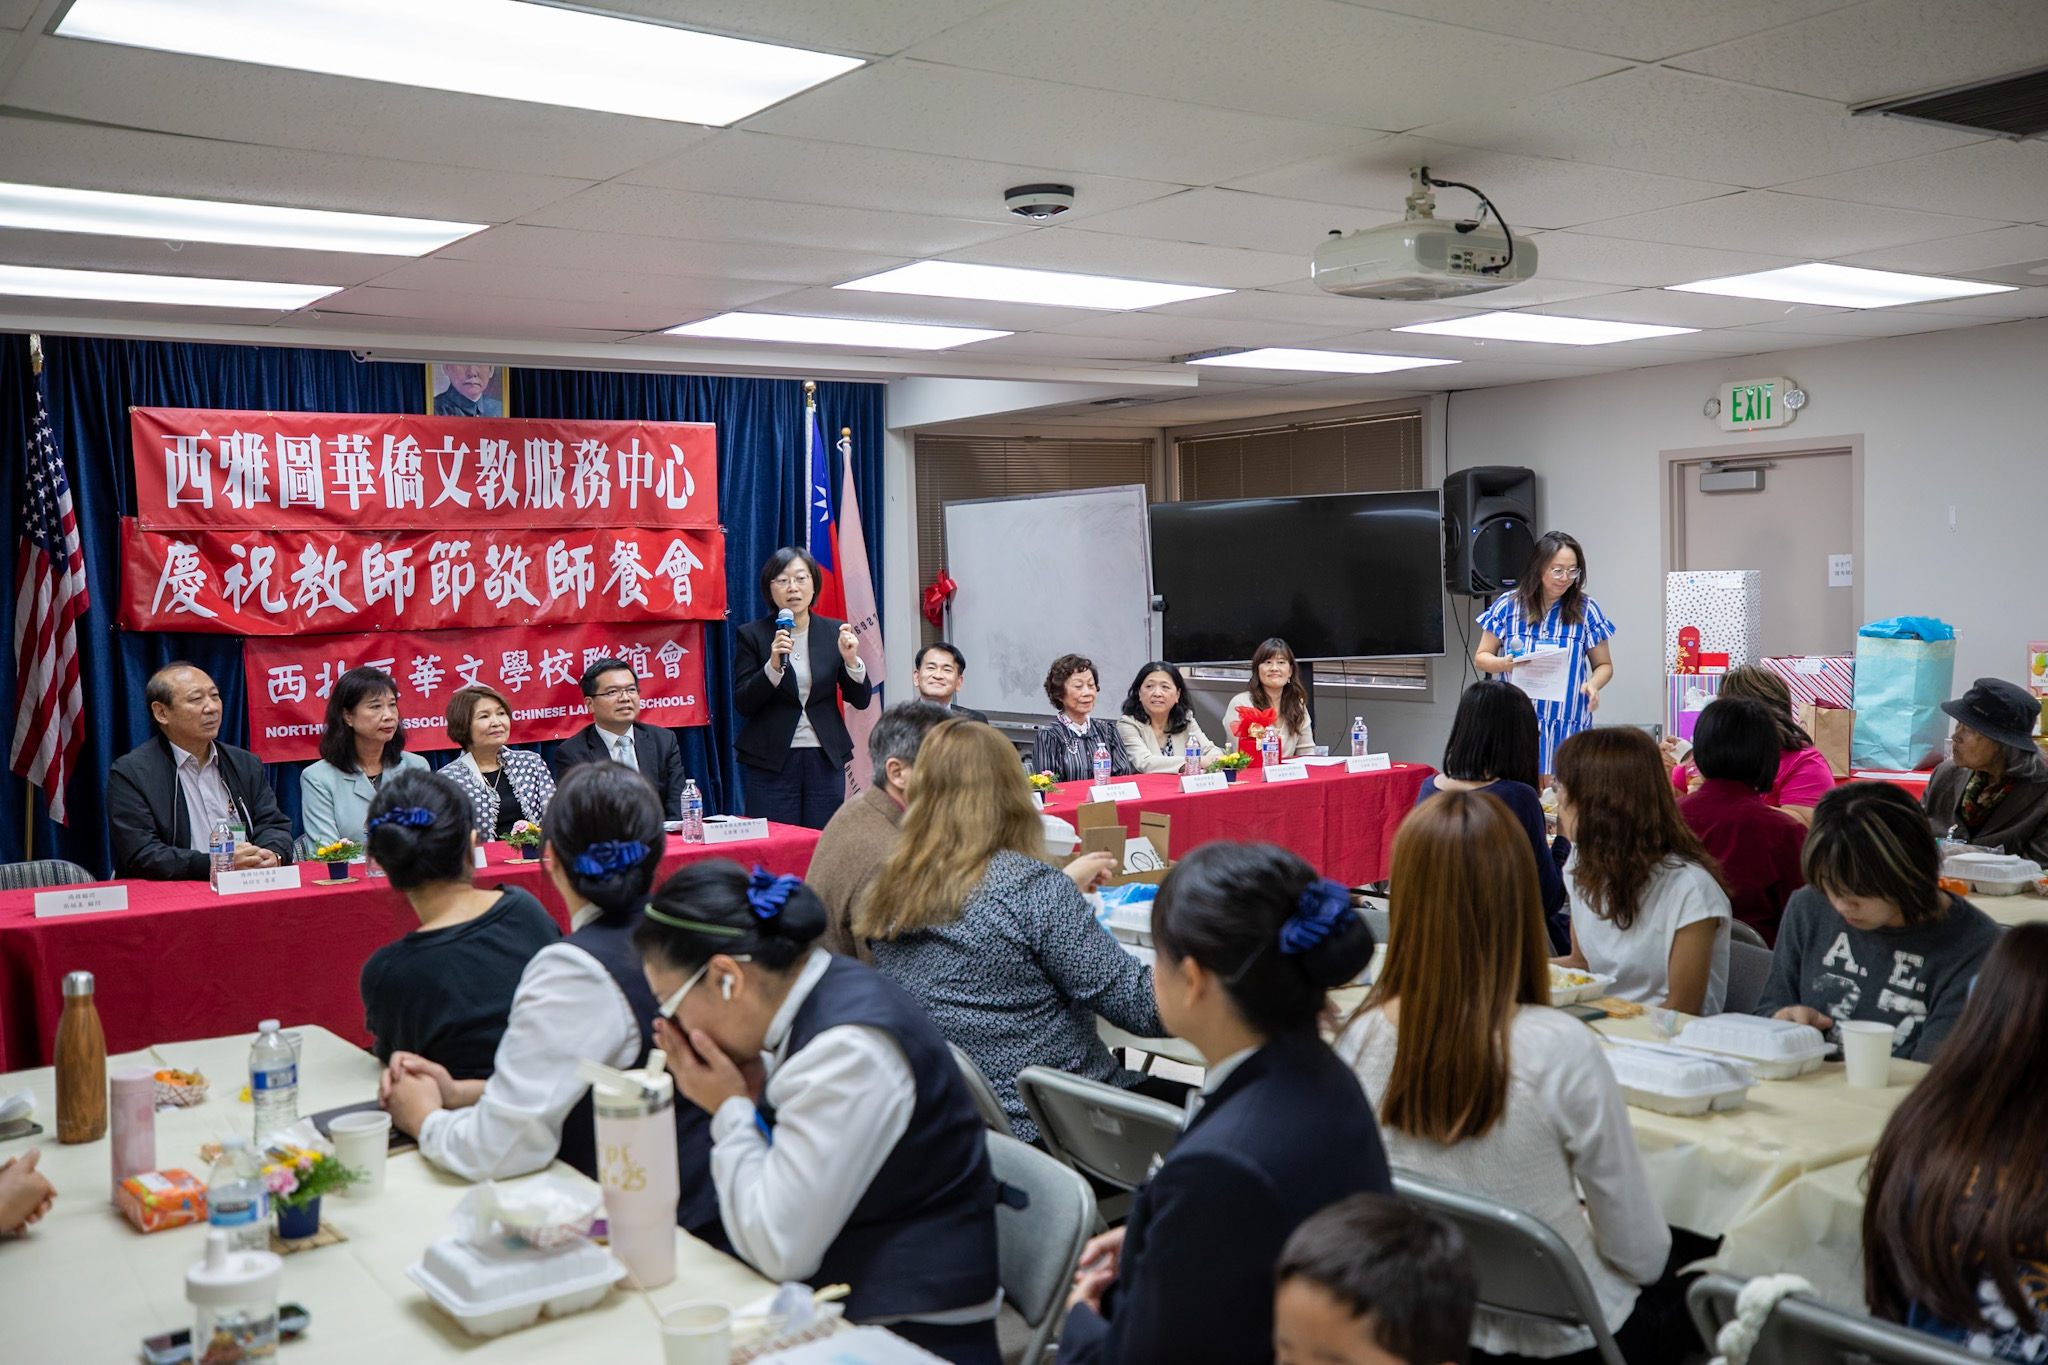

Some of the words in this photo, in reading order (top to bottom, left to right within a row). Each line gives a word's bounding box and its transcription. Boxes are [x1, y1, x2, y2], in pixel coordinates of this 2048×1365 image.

[1732, 383, 1775, 423] EXIT
[161, 428, 695, 510] 西雅圖華僑文教服務中心
[152, 538, 703, 619] 慶祝教師節敬師餐會
[512, 706, 566, 721] CHINESE
[639, 694, 695, 709] SCHOOLS
[1822, 931, 1868, 977] A.
[1889, 950, 1927, 992] E.
